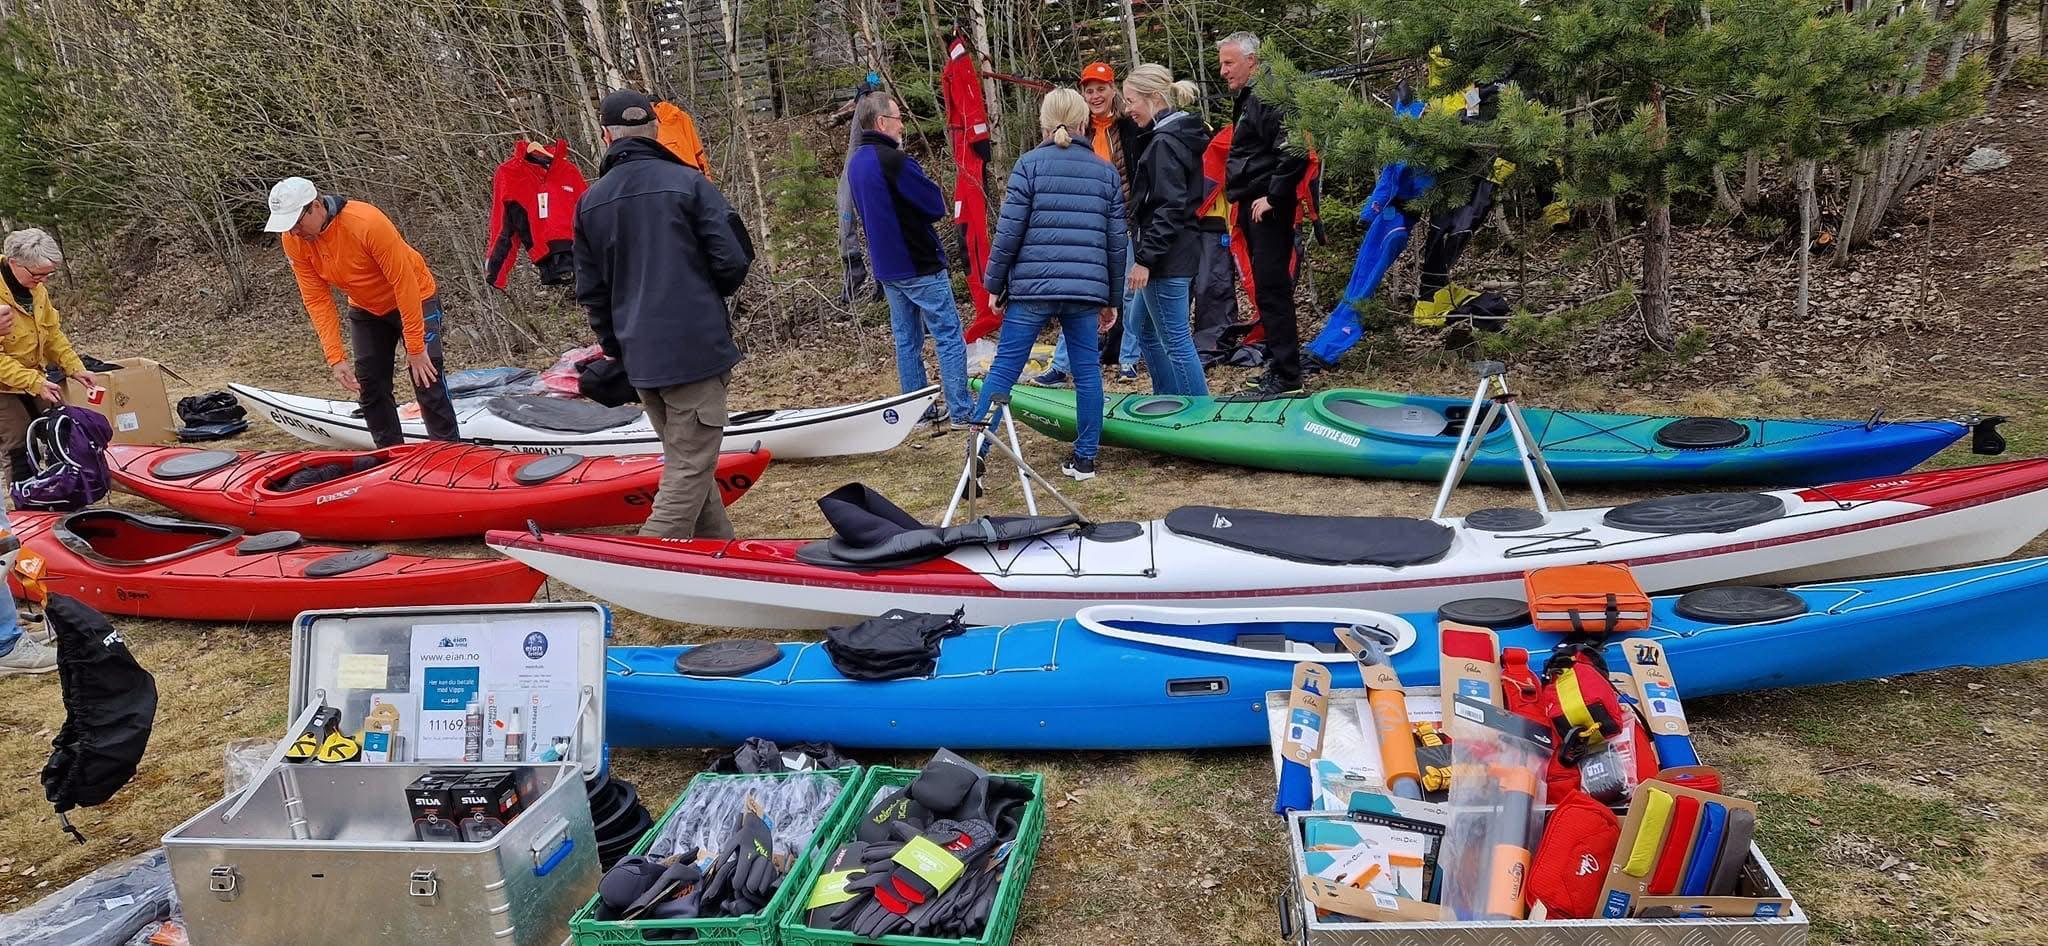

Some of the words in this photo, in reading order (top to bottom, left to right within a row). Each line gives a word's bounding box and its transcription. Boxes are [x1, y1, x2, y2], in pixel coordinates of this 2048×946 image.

[270, 408, 332, 439] eian.no
[1303, 421, 1341, 441] LIFESTYLE
[1338, 432, 1361, 448] SOLO
[420, 653, 480, 661] www.eian.no
[429, 719, 466, 731] 11169
[415, 798, 442, 806] SILVA
